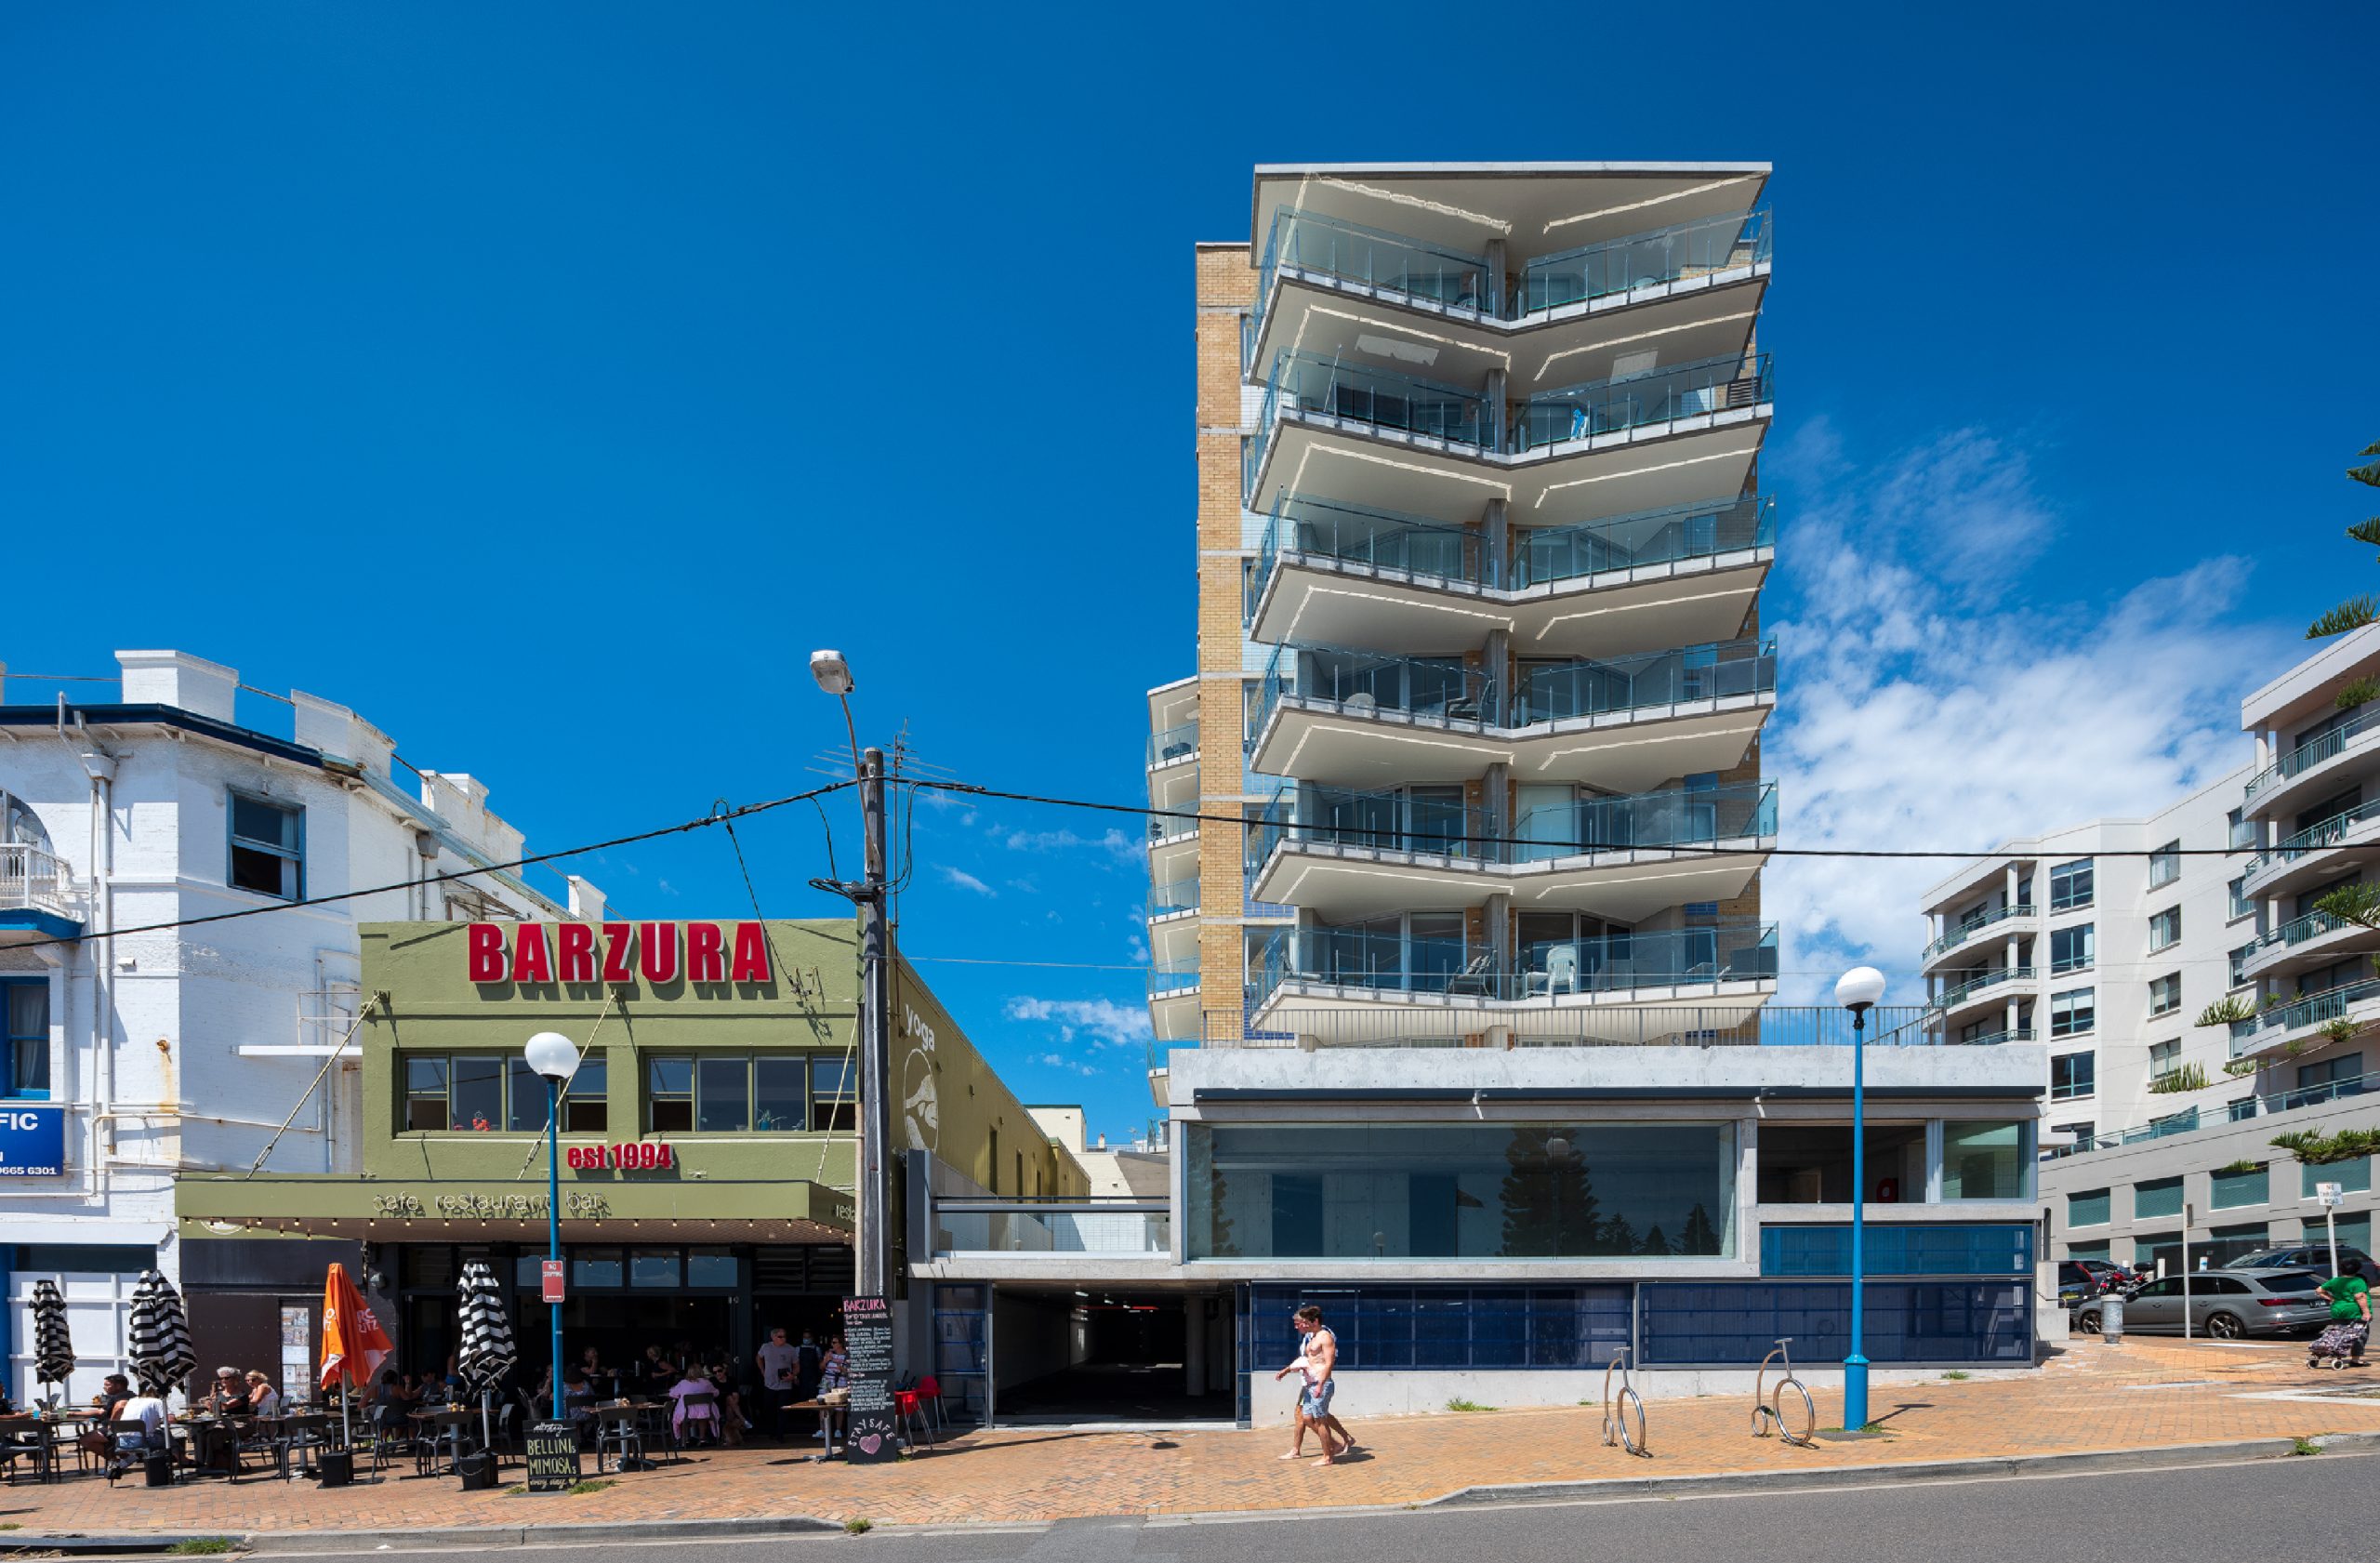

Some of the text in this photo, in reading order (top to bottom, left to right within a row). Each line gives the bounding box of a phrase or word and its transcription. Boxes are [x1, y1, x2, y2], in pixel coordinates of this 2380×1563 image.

[469, 922, 771, 983] BARZURA
[906, 1003, 935, 1052] yoga
[567, 1143, 673, 1169] est 1994
[28, 1166, 57, 1175] 6301
[373, 1190, 603, 1212] cafe restaurant bar
[843, 1298, 886, 1313] BARZURA
